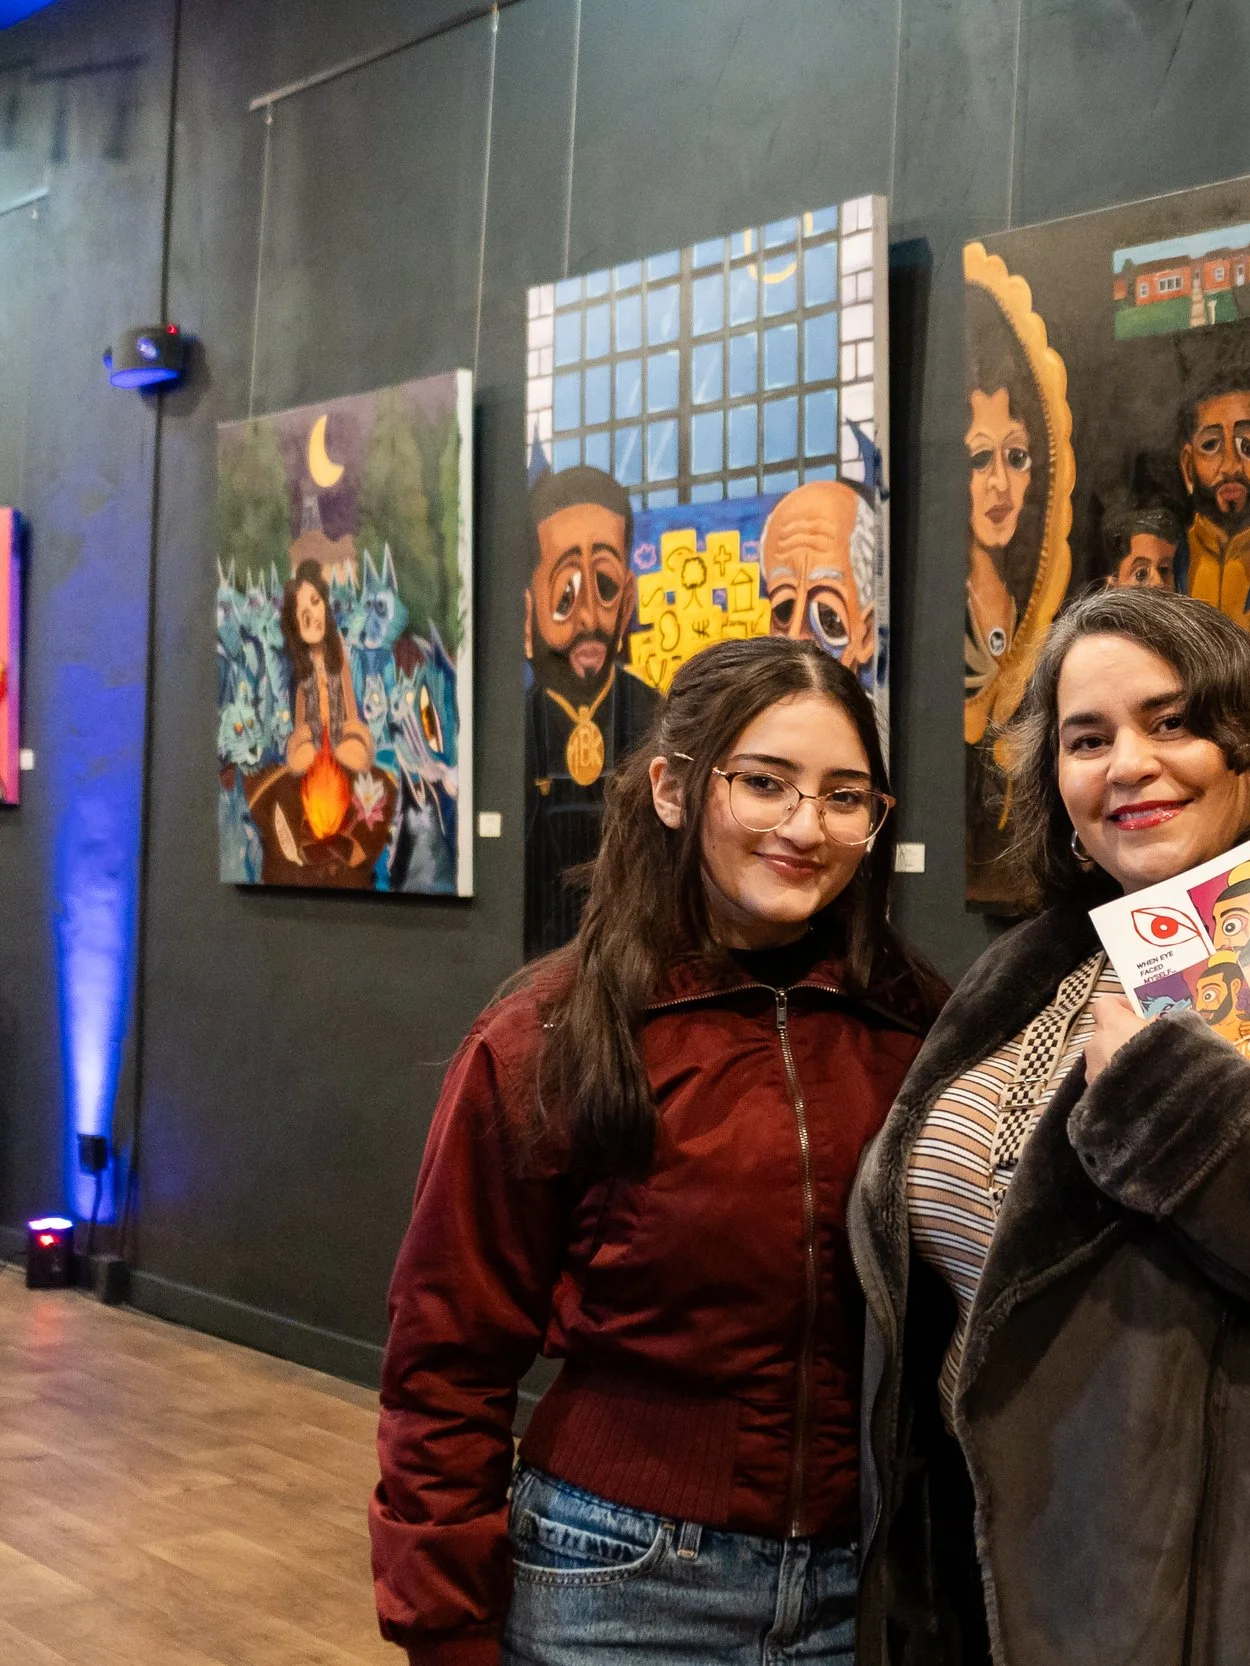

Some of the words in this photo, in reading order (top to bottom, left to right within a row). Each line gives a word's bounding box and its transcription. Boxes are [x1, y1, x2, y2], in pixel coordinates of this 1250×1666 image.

[1136, 956, 1159, 970] WHEN
[1159, 950, 1174, 961] EYE
[1140, 963, 1164, 977] FACED
